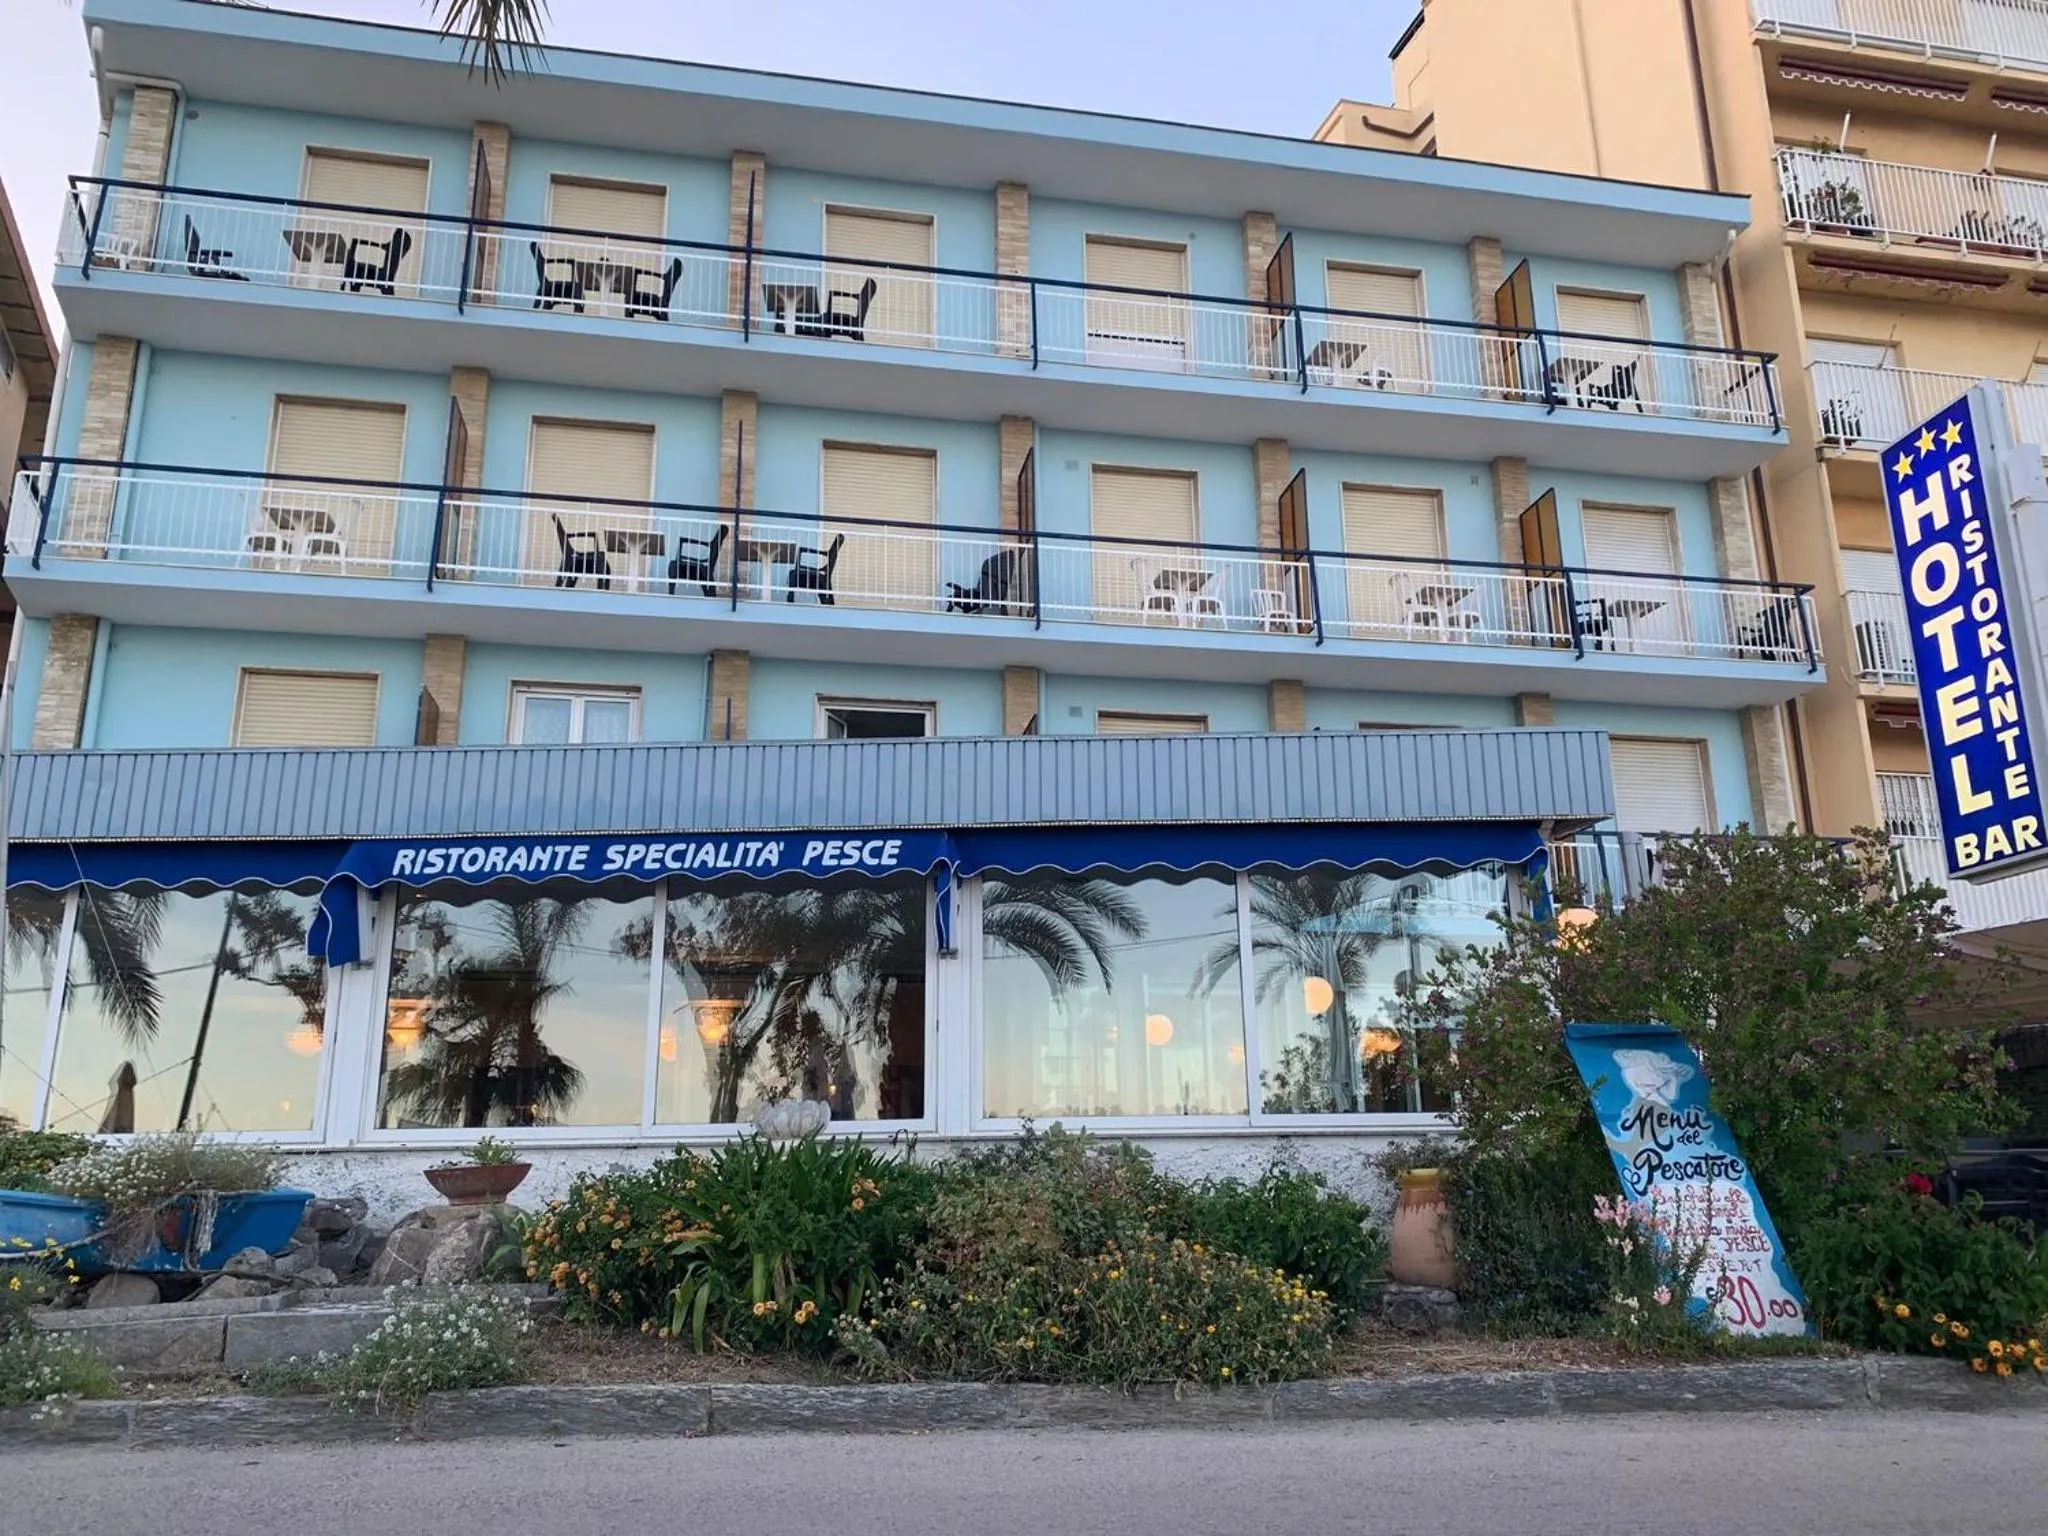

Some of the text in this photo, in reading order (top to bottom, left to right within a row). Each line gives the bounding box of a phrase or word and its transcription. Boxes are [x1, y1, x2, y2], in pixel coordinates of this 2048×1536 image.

[1898, 470, 1994, 816] HOTEL
[1948, 453, 2030, 800] RISTORANTE
[392, 845, 590, 876] RISTORANTE
[802, 840, 902, 866] PESCE
[1954, 815, 2042, 868] BAR
[1677, 1130, 1704, 1146] del
[1622, 1148, 1745, 1196] Pescatore
[1719, 1235, 1771, 1253] PESCE
